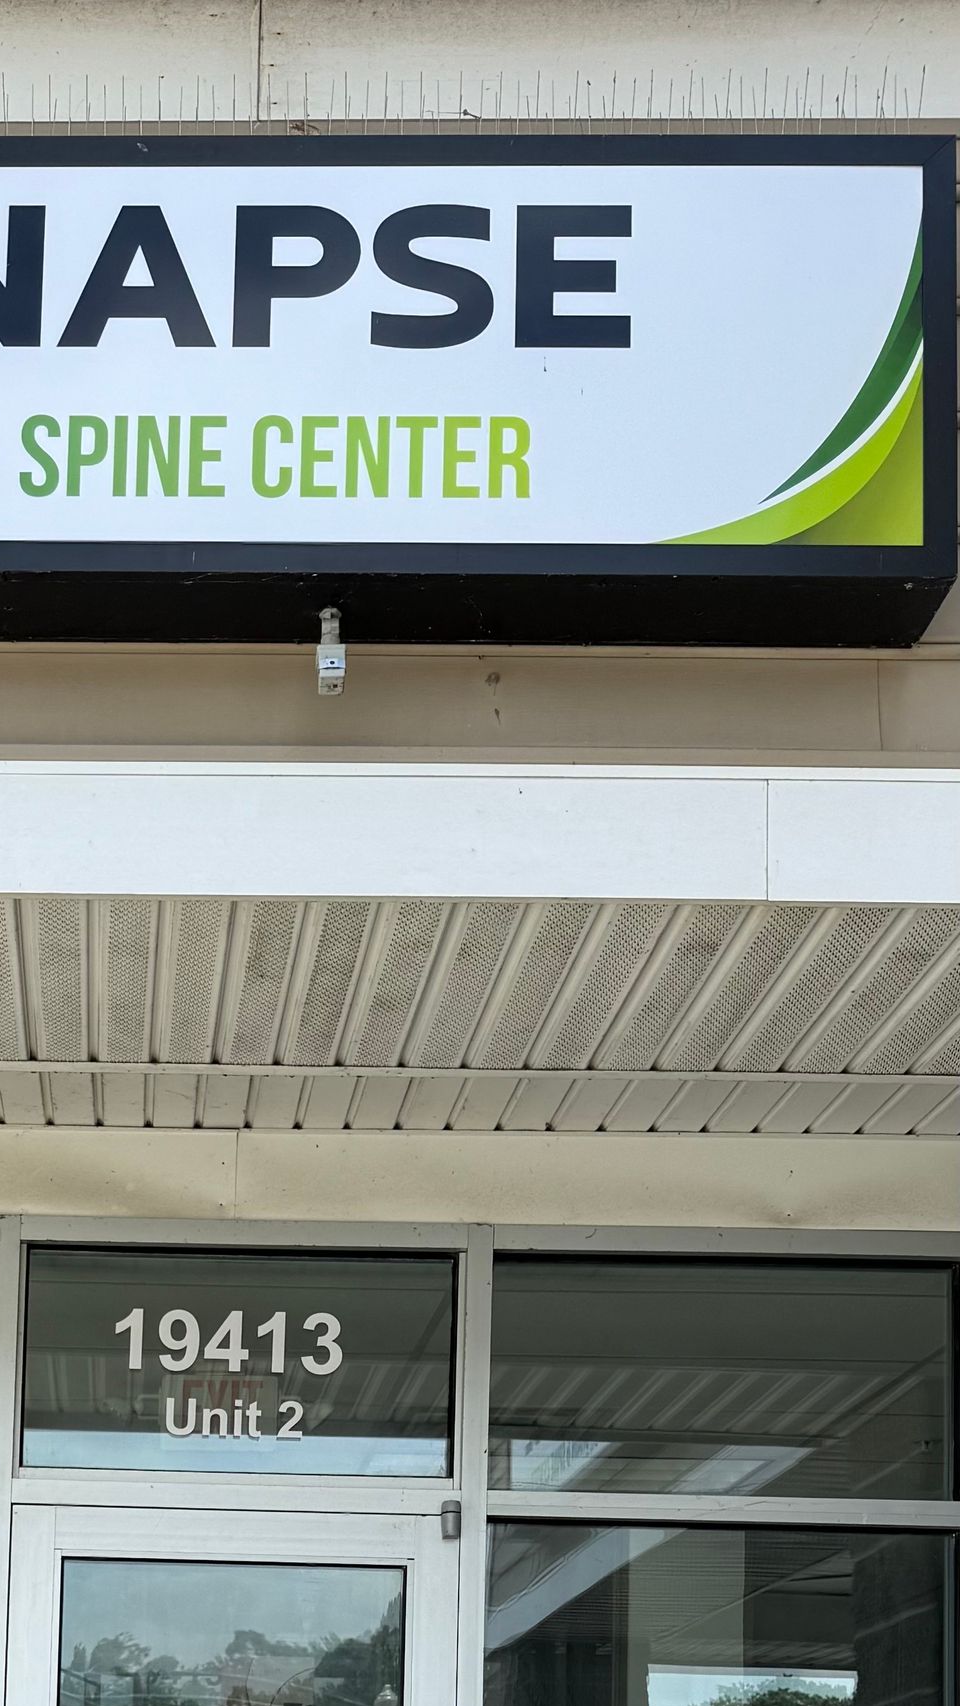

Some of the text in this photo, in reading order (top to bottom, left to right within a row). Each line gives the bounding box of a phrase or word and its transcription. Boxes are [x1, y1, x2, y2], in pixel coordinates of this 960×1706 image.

[19, 414, 228, 498] SPINE
[250, 414, 532, 499] CENTER
[115, 1308, 344, 1376] 19413
[166, 1397, 304, 1440] Unit 2
